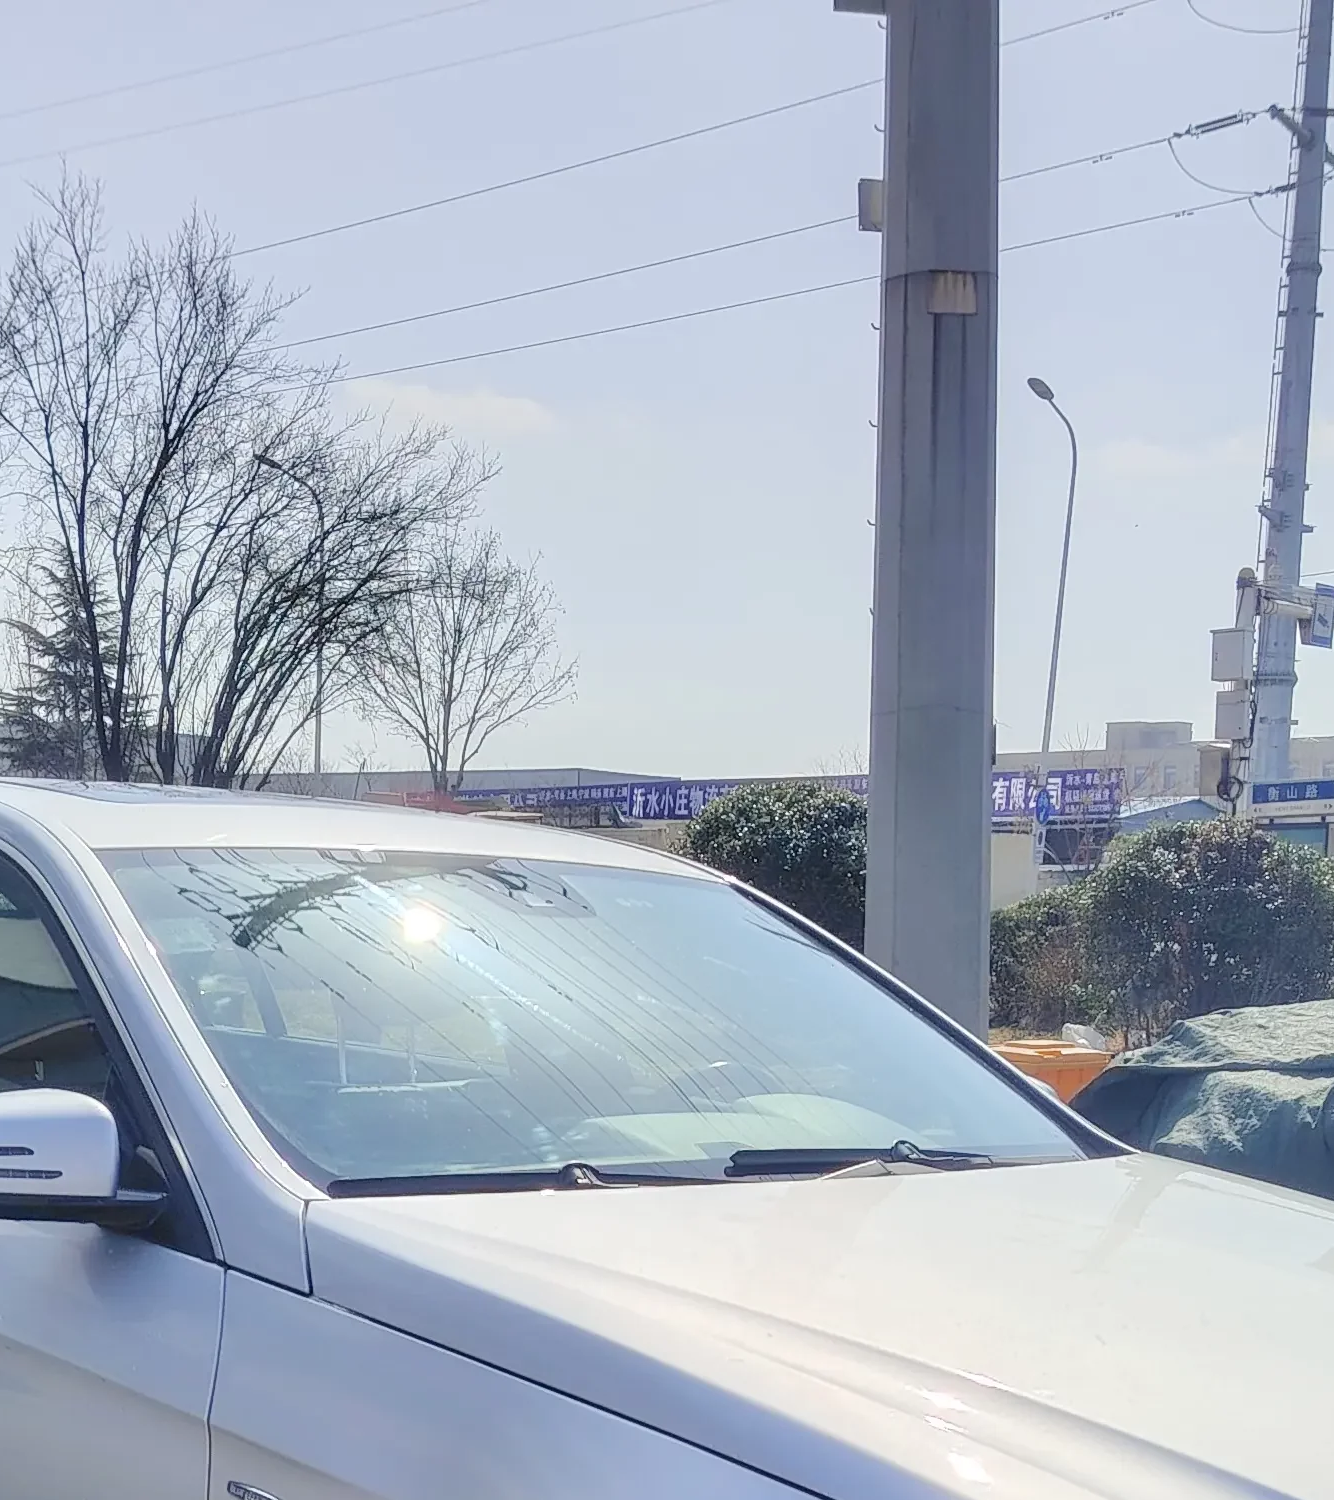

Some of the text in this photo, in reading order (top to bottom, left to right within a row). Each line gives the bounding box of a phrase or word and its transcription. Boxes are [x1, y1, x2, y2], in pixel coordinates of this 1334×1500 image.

[632, 783, 739, 818] 沂水小庄物流
